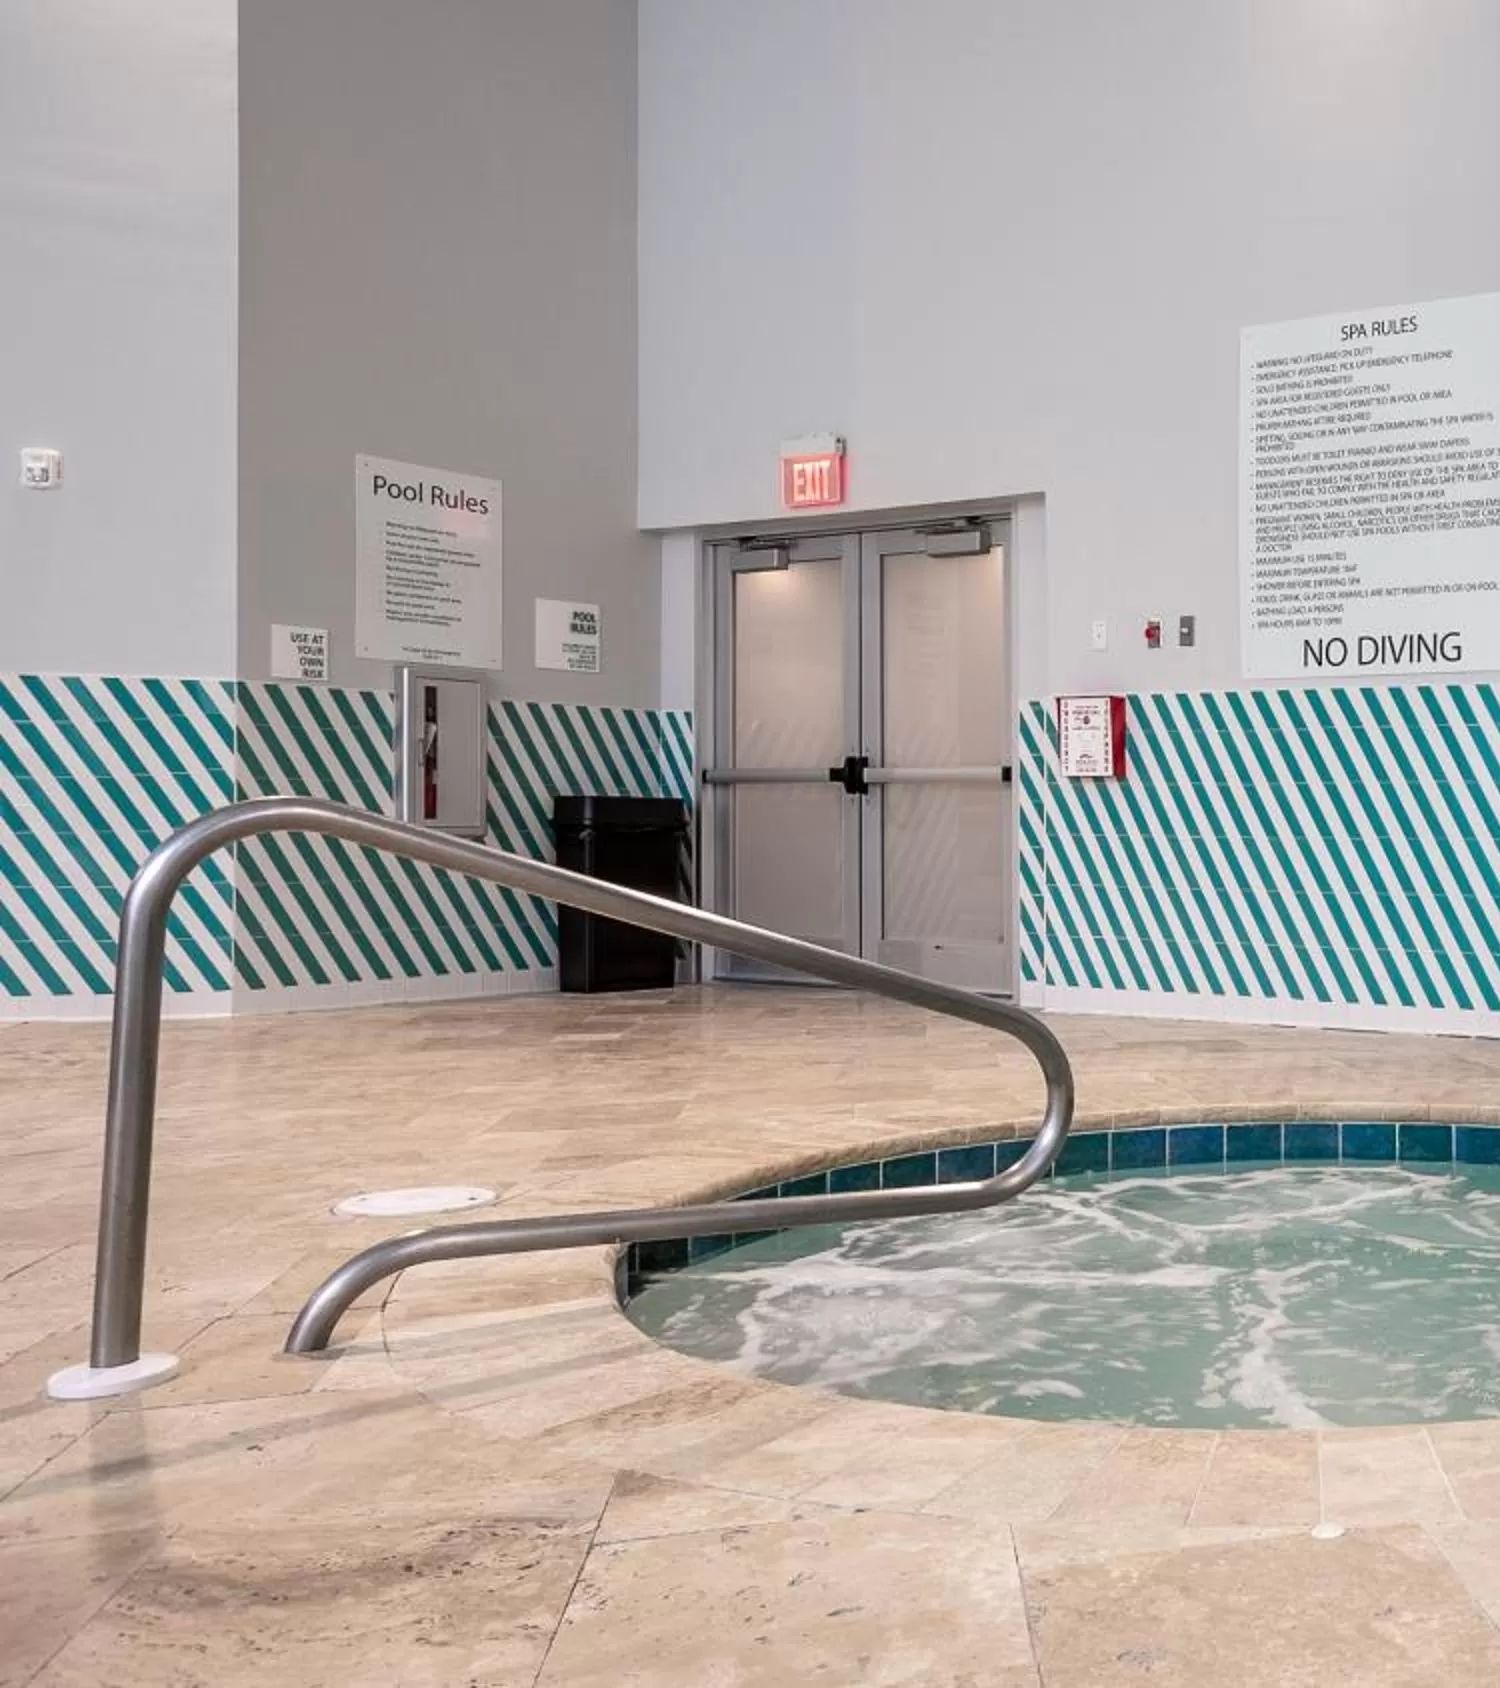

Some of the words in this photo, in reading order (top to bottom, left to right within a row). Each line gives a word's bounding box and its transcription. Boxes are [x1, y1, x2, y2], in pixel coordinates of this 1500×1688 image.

[1341, 323, 1367, 341] SPA
[1371, 316, 1418, 337] RULES
[372, 475, 423, 503] Pool
[431, 485, 489, 515] Rules
[793, 461, 832, 502] EXIT
[290, 632, 309, 644] USE
[312, 634, 324, 645] AT
[1303, 637, 1349, 668] NO
[1357, 631, 1463, 666] DIVING
